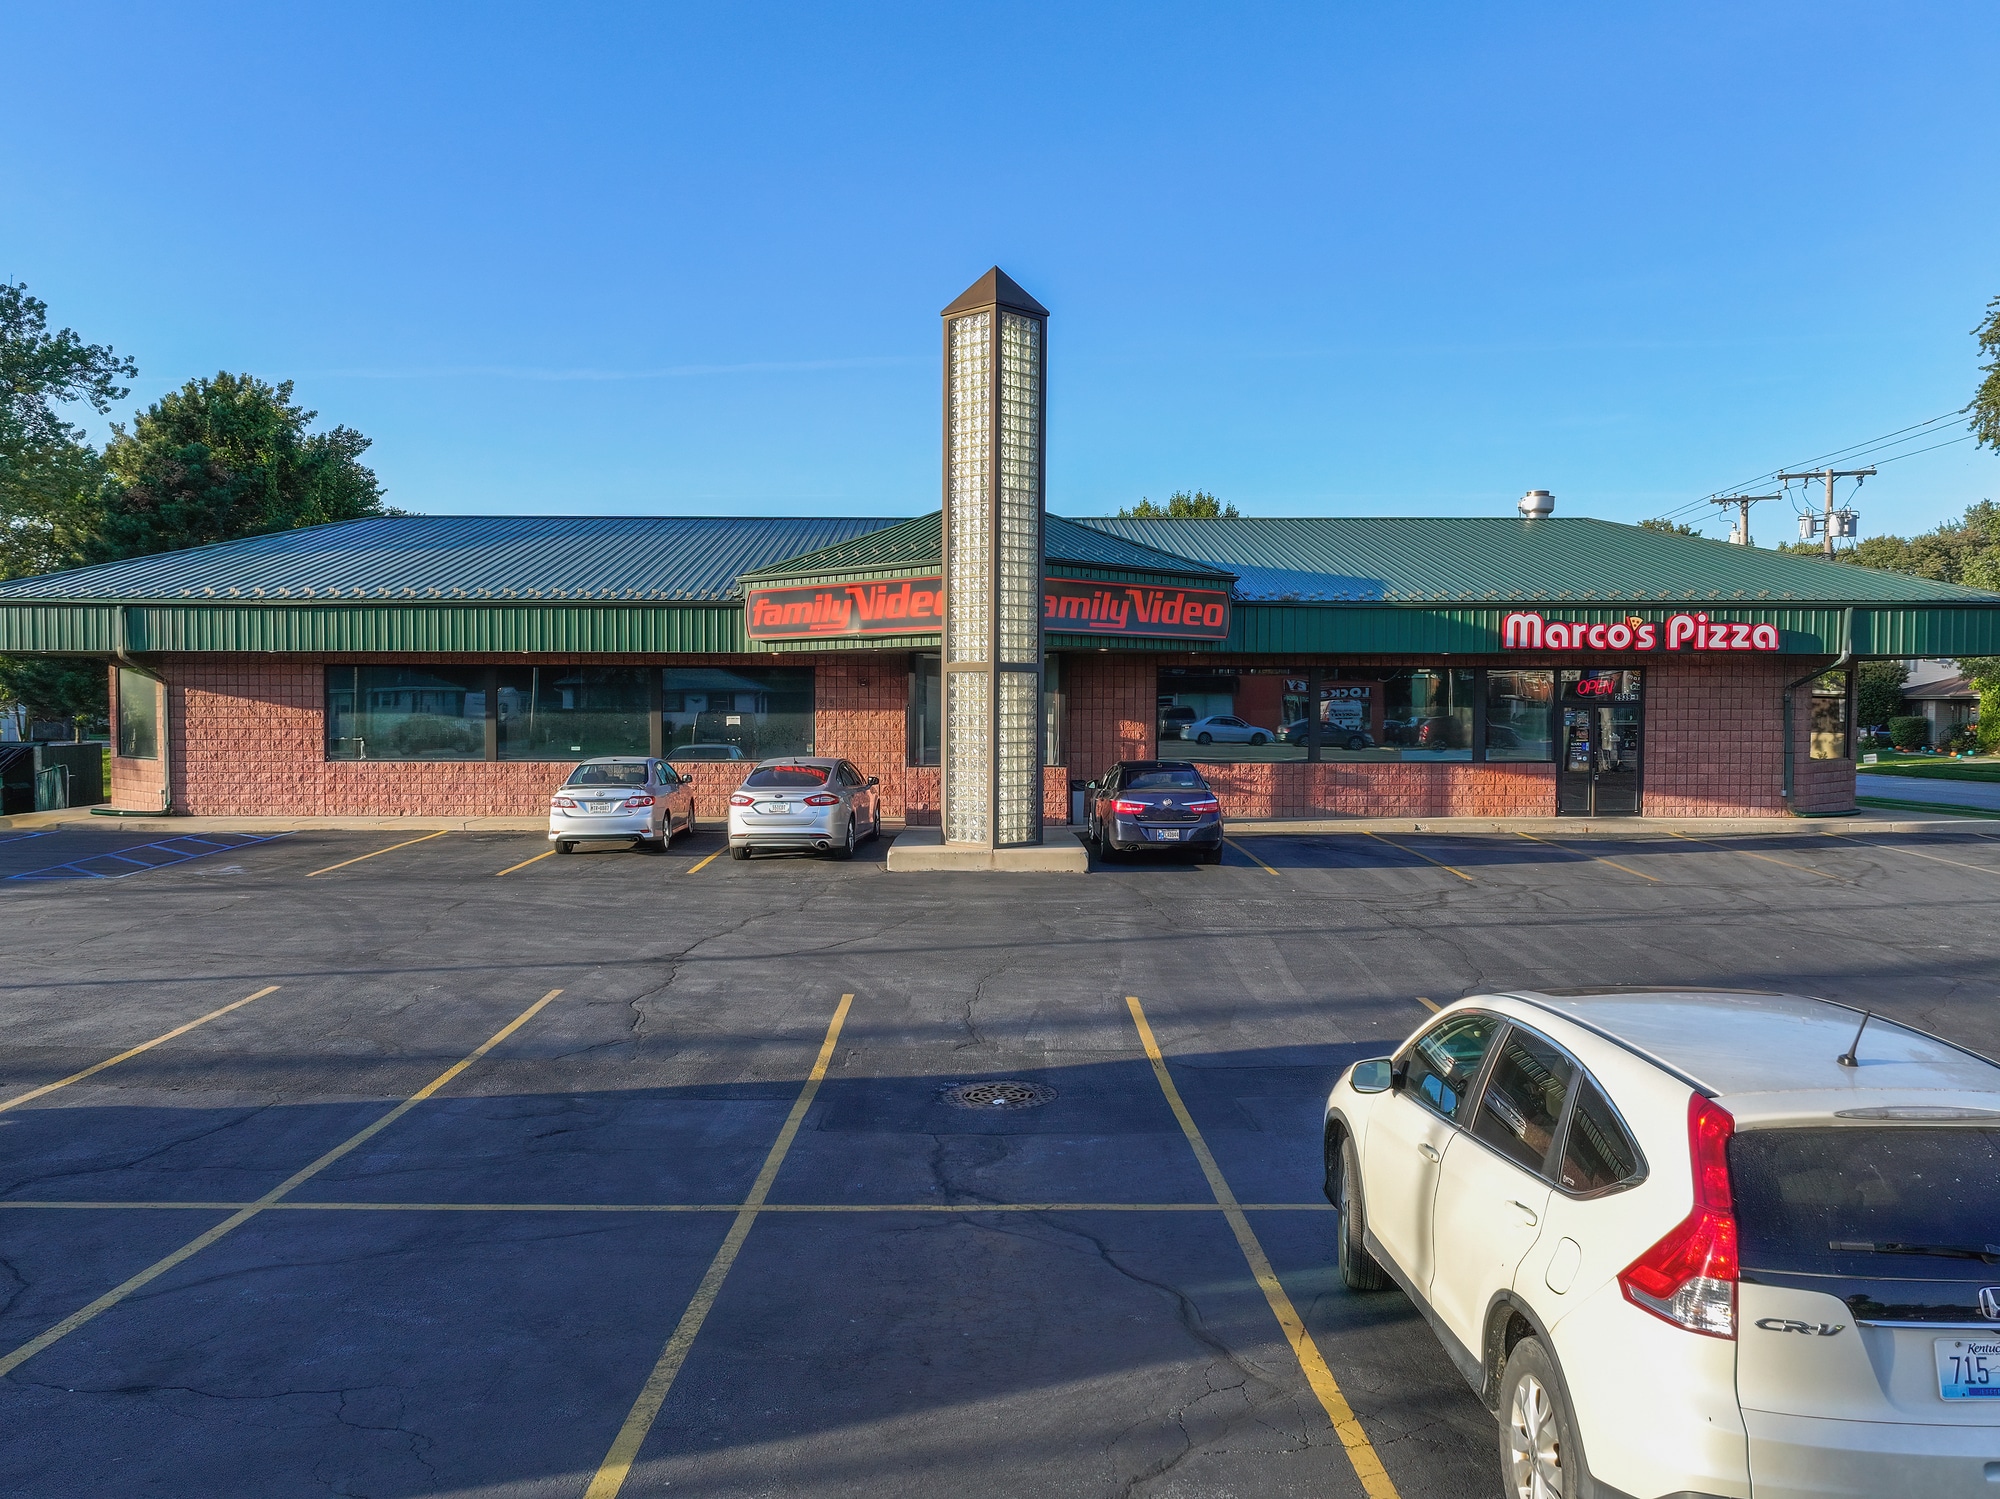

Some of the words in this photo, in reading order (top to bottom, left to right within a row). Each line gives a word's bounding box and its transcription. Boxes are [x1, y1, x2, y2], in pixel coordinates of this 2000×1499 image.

[752, 594, 852, 630] family
[1044, 591, 1130, 629] amily
[1125, 589, 1225, 627] Video
[1503, 612, 1656, 651] Marco's
[1665, 612, 1780, 651] Pizza
[1577, 679, 1615, 695] OPEN
[1949, 1356, 1989, 1384] 715
